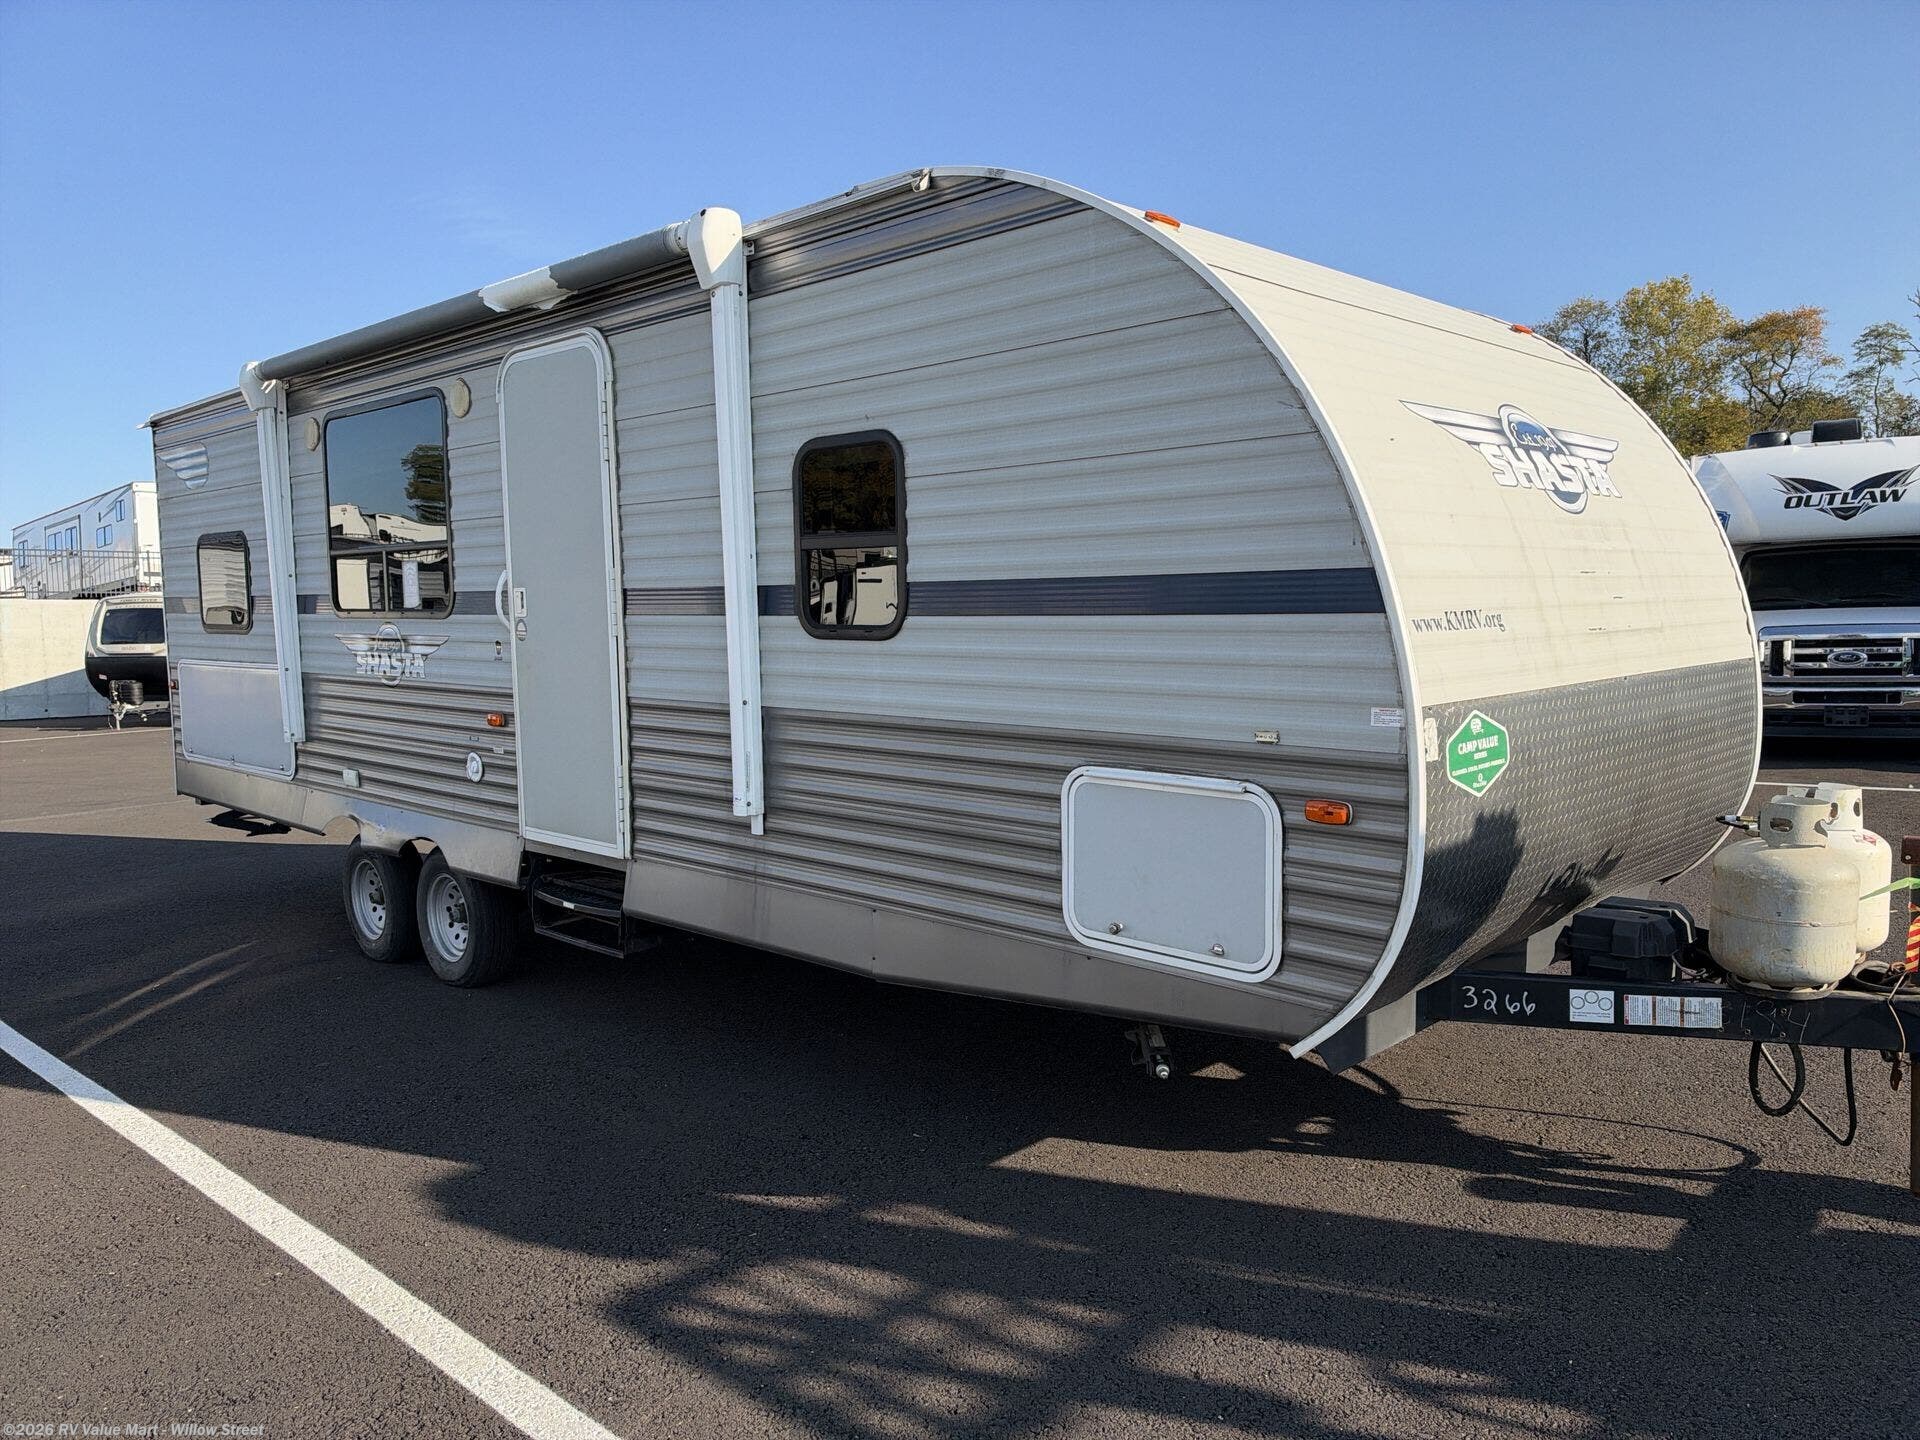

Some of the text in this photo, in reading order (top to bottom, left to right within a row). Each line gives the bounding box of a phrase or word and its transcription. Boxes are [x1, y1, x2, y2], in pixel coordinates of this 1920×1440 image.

[1479, 443, 1622, 498] SHASTA
[1784, 488, 1907, 509] OUTLAW
[1412, 609, 1505, 632] www.KMRV.org
[1458, 740, 1477, 755] CAMP
[1477, 735, 1499, 750] VALUE
[1462, 985, 1536, 1016] 3266
